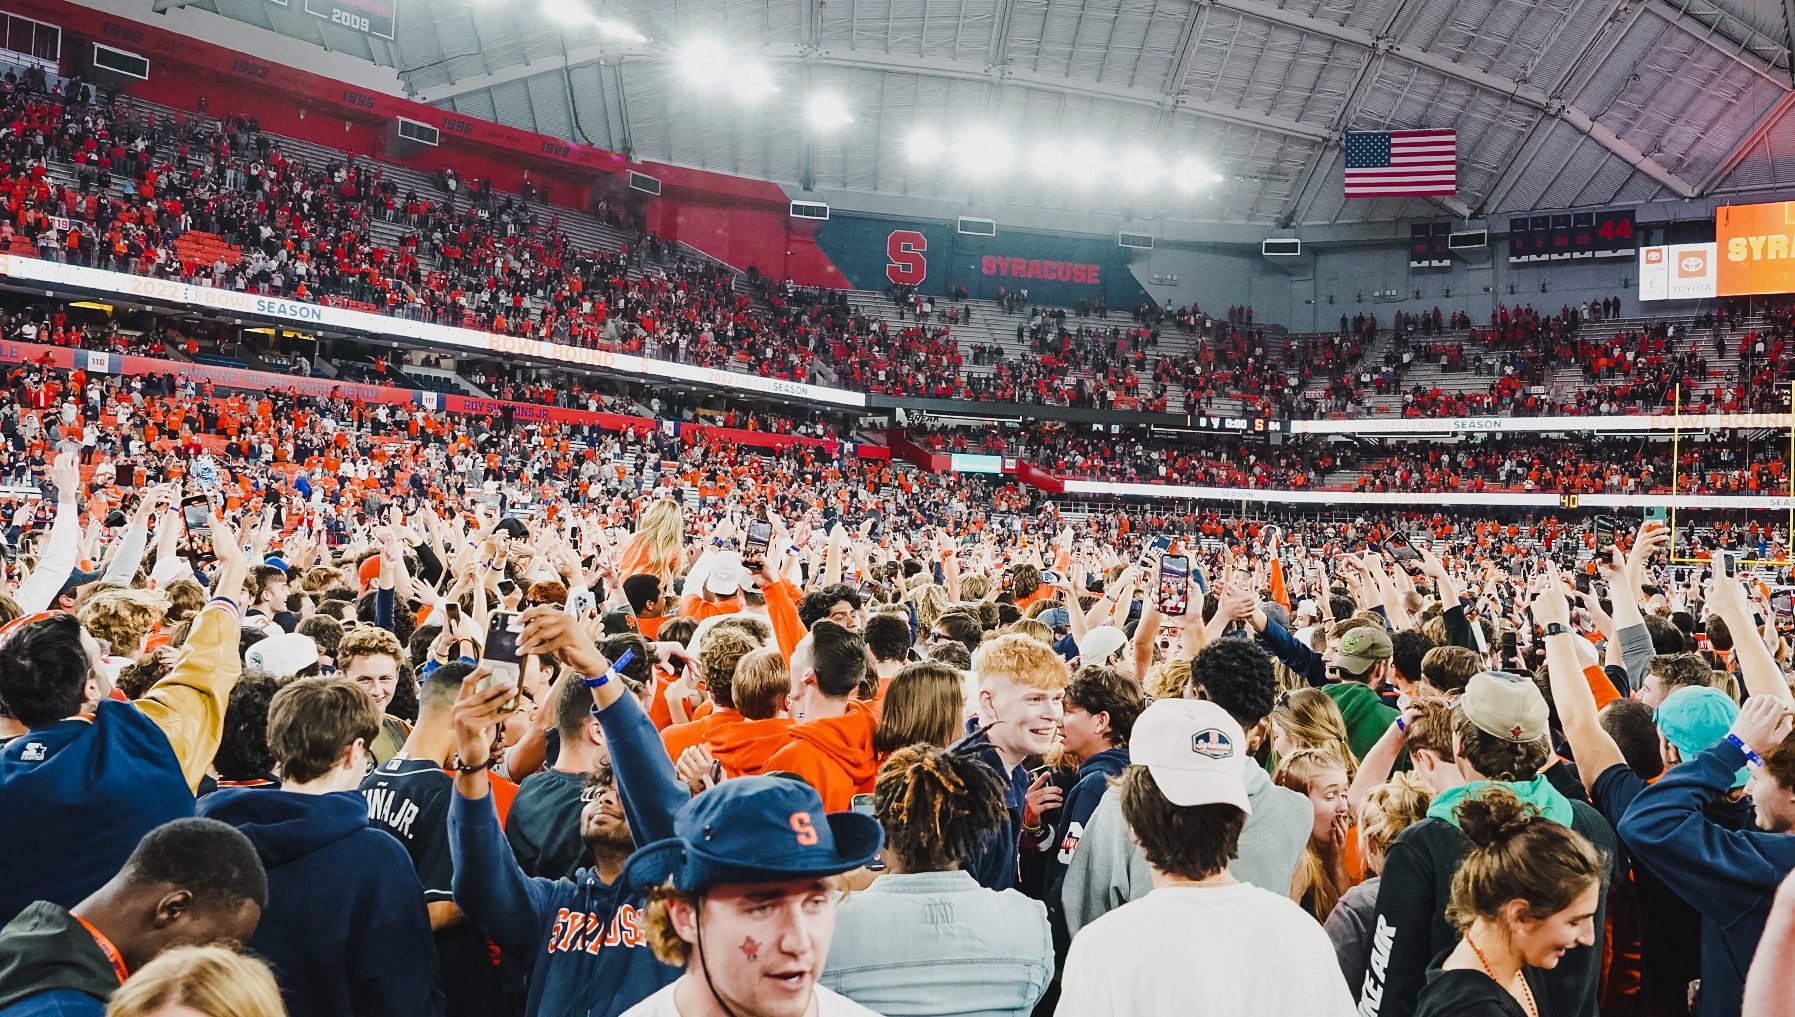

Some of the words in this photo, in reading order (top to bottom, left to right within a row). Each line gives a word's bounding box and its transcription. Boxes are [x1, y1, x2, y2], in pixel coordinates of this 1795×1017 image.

[331, 8, 370, 33] 2009
[1599, 218, 1633, 240] 44
[886, 230, 927, 286] S
[1728, 234, 1795, 262] SYR
[981, 255, 1100, 285] SYRACUSE
[131, 278, 180, 299] 2022
[205, 290, 253, 309] BOWL
[256, 299, 322, 321] SEASON
[1673, 284, 1712, 293] TOYOTA
[91, 357, 105, 366] 116
[487, 334, 546, 359] BOWL
[551, 344, 616, 368] BOUND
[709, 371, 734, 385] 2022
[746, 376, 773, 390] BOWL
[773, 382, 808, 395] SEASON
[424, 397, 435, 405] 117
[464, 400, 485, 411] ROY
[536, 408, 550, 418] JR.
[1254, 418, 1264, 431] S
[1375, 421, 1403, 430] 2022
[1419, 421, 1452, 429] BOWL
[1453, 420, 1502, 429] SEASON
[1650, 415, 1708, 429] BOWL
[1719, 413, 1795, 428] BOUND
[1221, 490, 1255, 499] SEASON
[1560, 495, 1578, 508] 40
[1769, 498, 1795, 506] SEA
[389, 798, 419, 839] JR.
[789, 811, 818, 846] S
[1370, 913, 1397, 984] AIR
